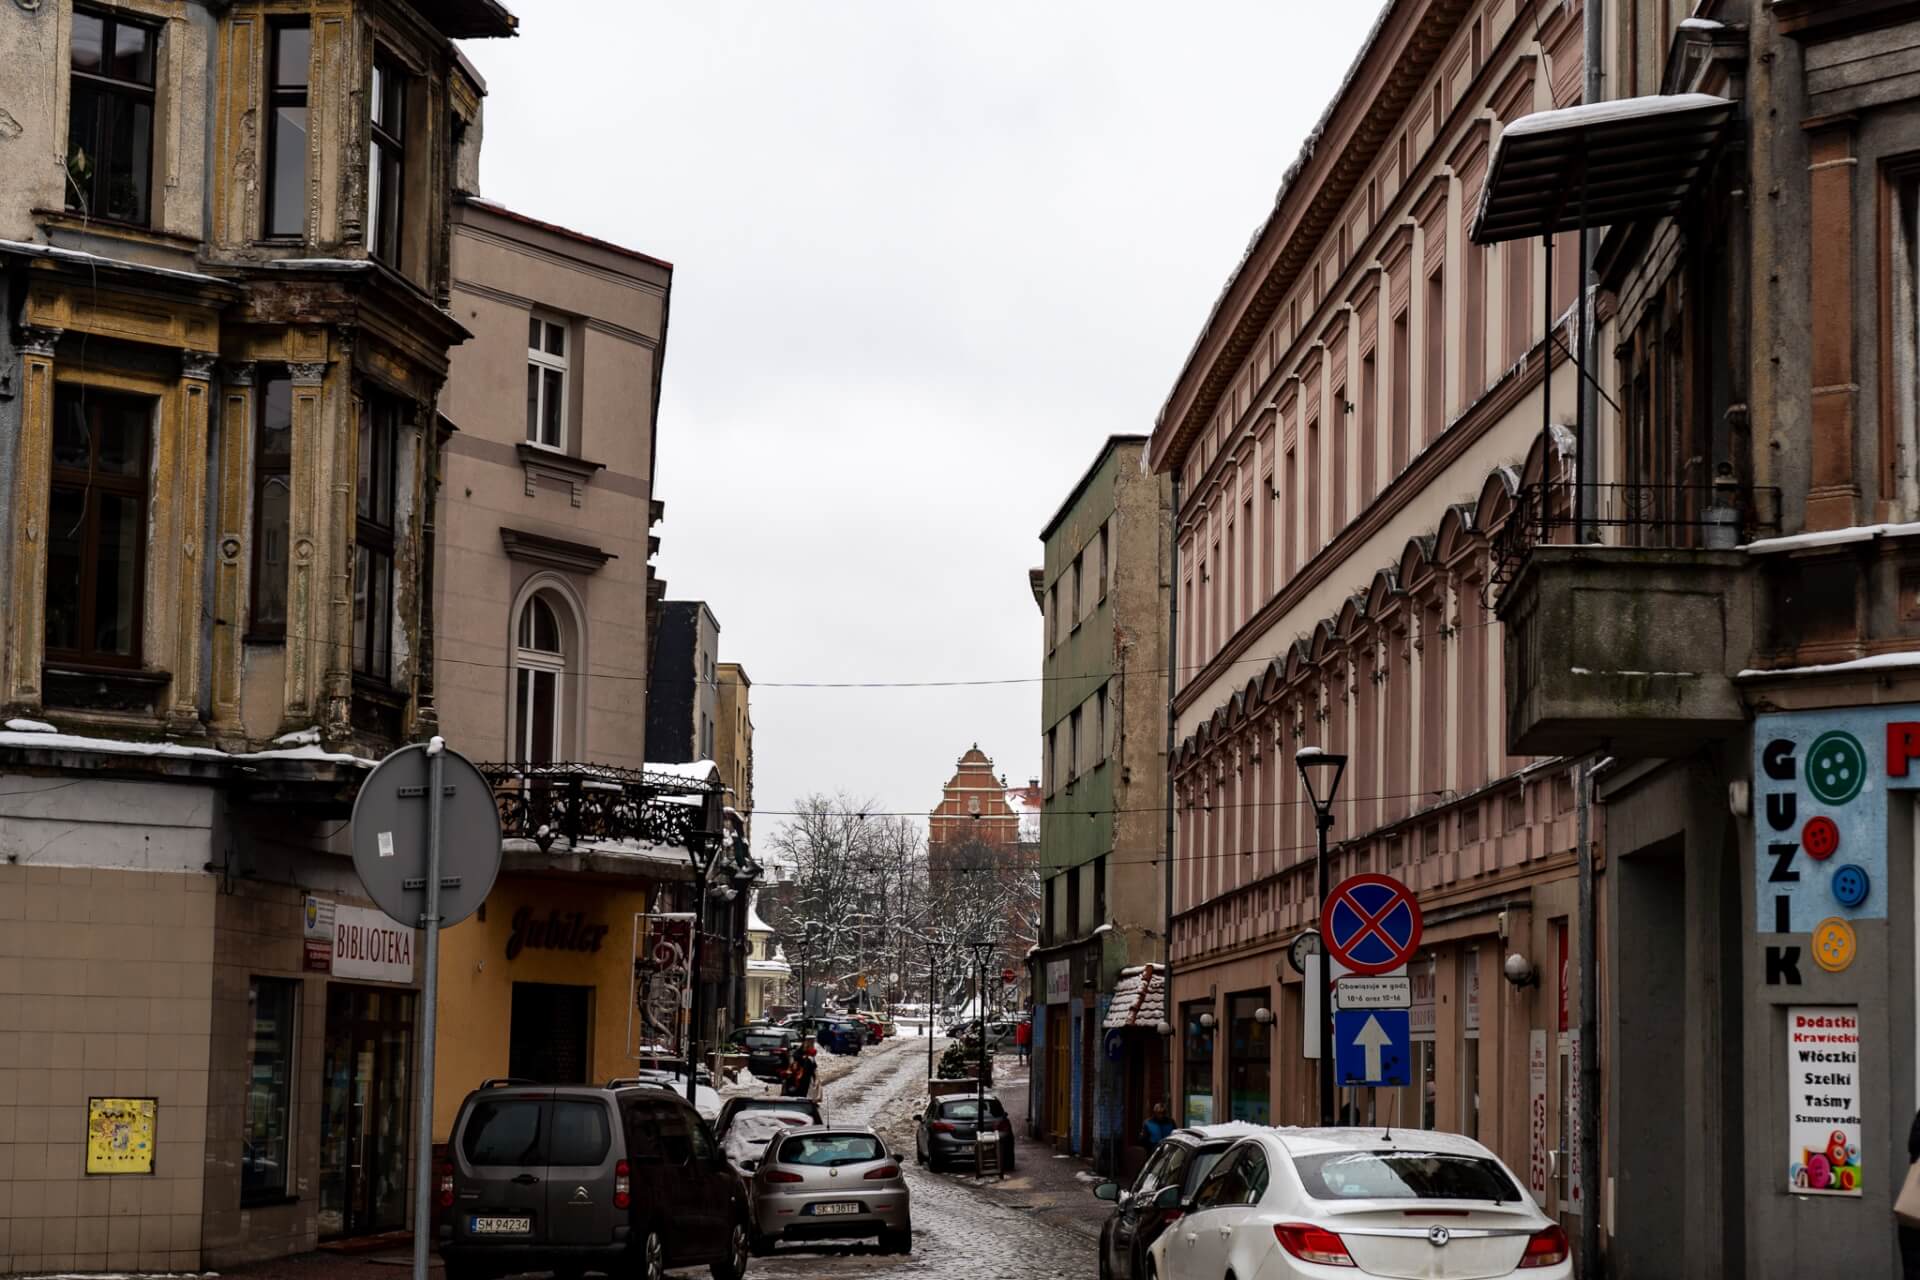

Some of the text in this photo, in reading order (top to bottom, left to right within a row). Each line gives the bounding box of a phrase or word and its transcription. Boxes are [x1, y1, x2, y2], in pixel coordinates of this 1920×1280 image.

[1763, 738, 1802, 986] GUZIK
[506, 904, 608, 960] Jubiler
[337, 924, 411, 966] BIBLIOTEKA
[1339, 983, 1380, 991] Obowiązuje
[1796, 1015, 1856, 1028] Dodatki
[1798, 1049, 1857, 1063] Włóczki
[1804, 1072, 1852, 1086] Szelki
[1804, 1094, 1852, 1110] Taśmy
[477, 1217, 529, 1232] SM 94234
